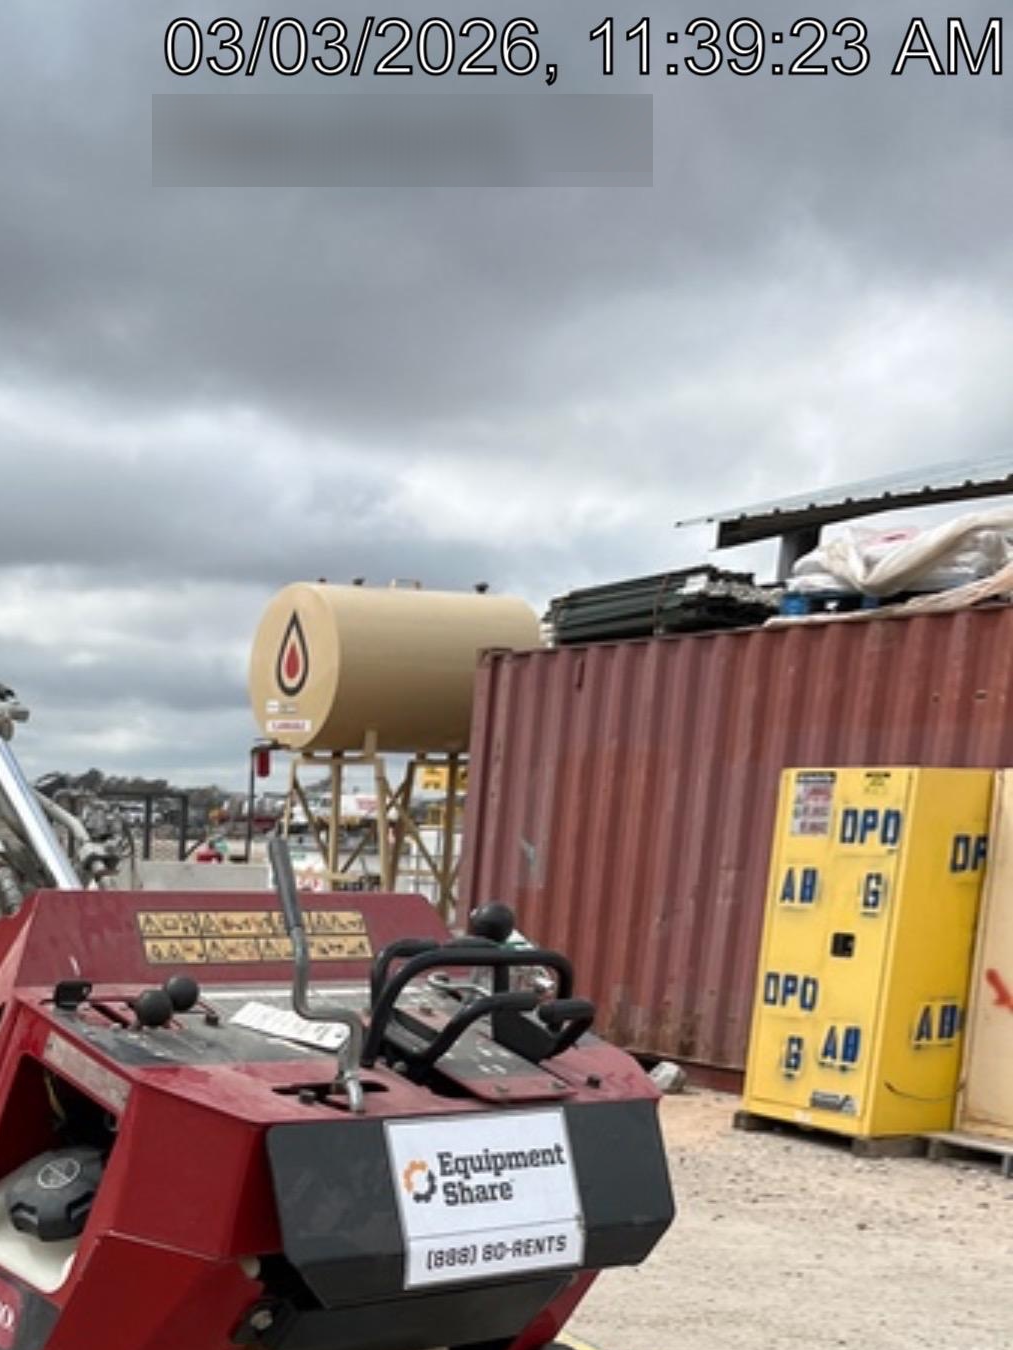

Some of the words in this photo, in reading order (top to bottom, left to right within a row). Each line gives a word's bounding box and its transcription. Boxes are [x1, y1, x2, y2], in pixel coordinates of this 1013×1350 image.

[436, 1142, 566, 1180] Equipment
[442, 1179, 514, 1206] Share
[426, 1244, 478, 1271] (888)
[481, 1234, 568, 1262] 80-RENTS
